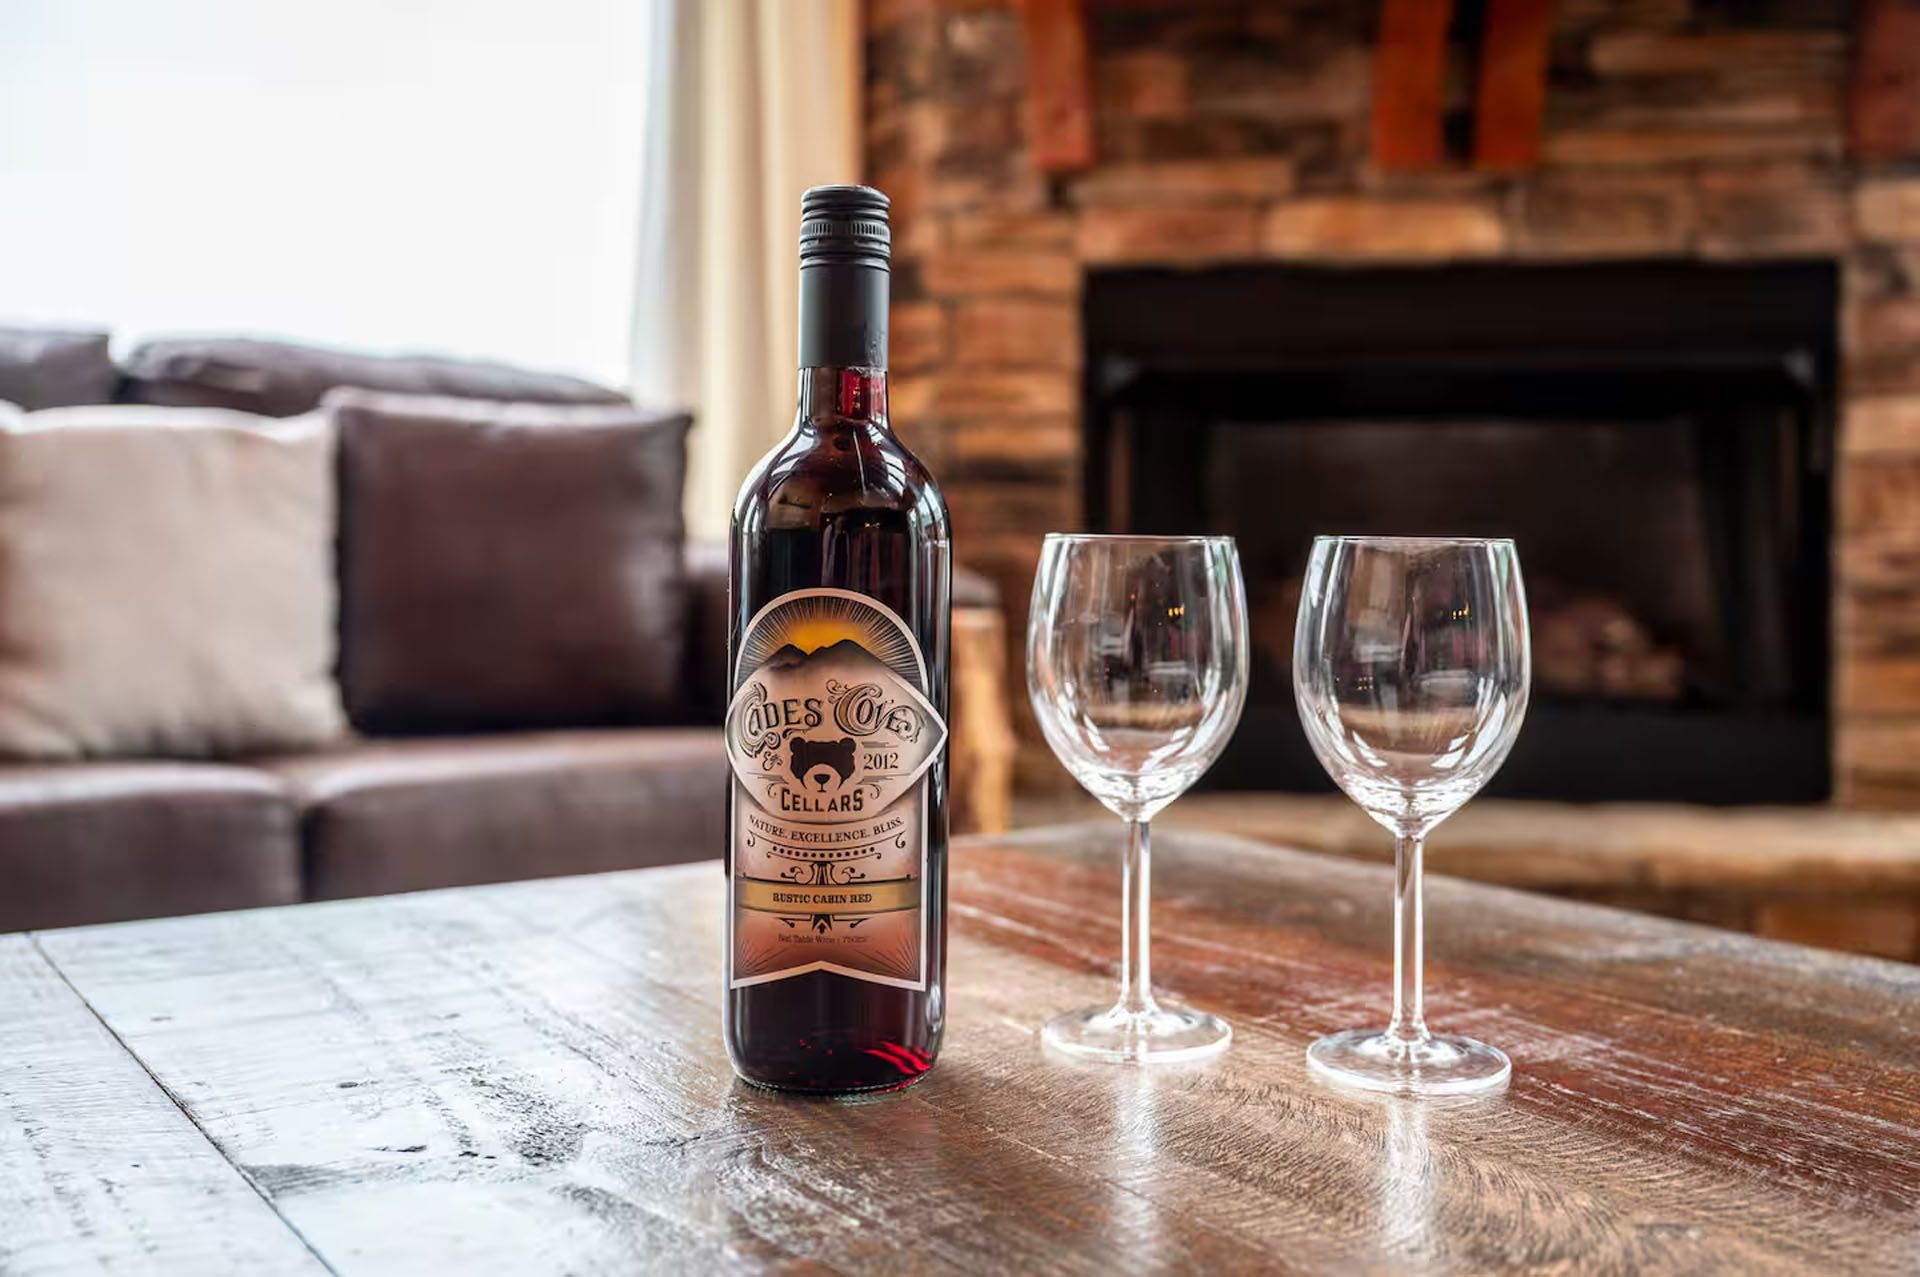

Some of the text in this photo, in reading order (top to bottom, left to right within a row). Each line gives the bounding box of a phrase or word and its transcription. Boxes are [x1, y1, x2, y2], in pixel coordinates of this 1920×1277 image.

[826, 679, 927, 743] COVE
[863, 752, 899, 770] 2012
[782, 787, 864, 812] CELLARS
[749, 813, 788, 839] NATURE.
[791, 829, 871, 843] EXCELLENCE.
[772, 892, 873, 904] RUSTIC CABIN RED
